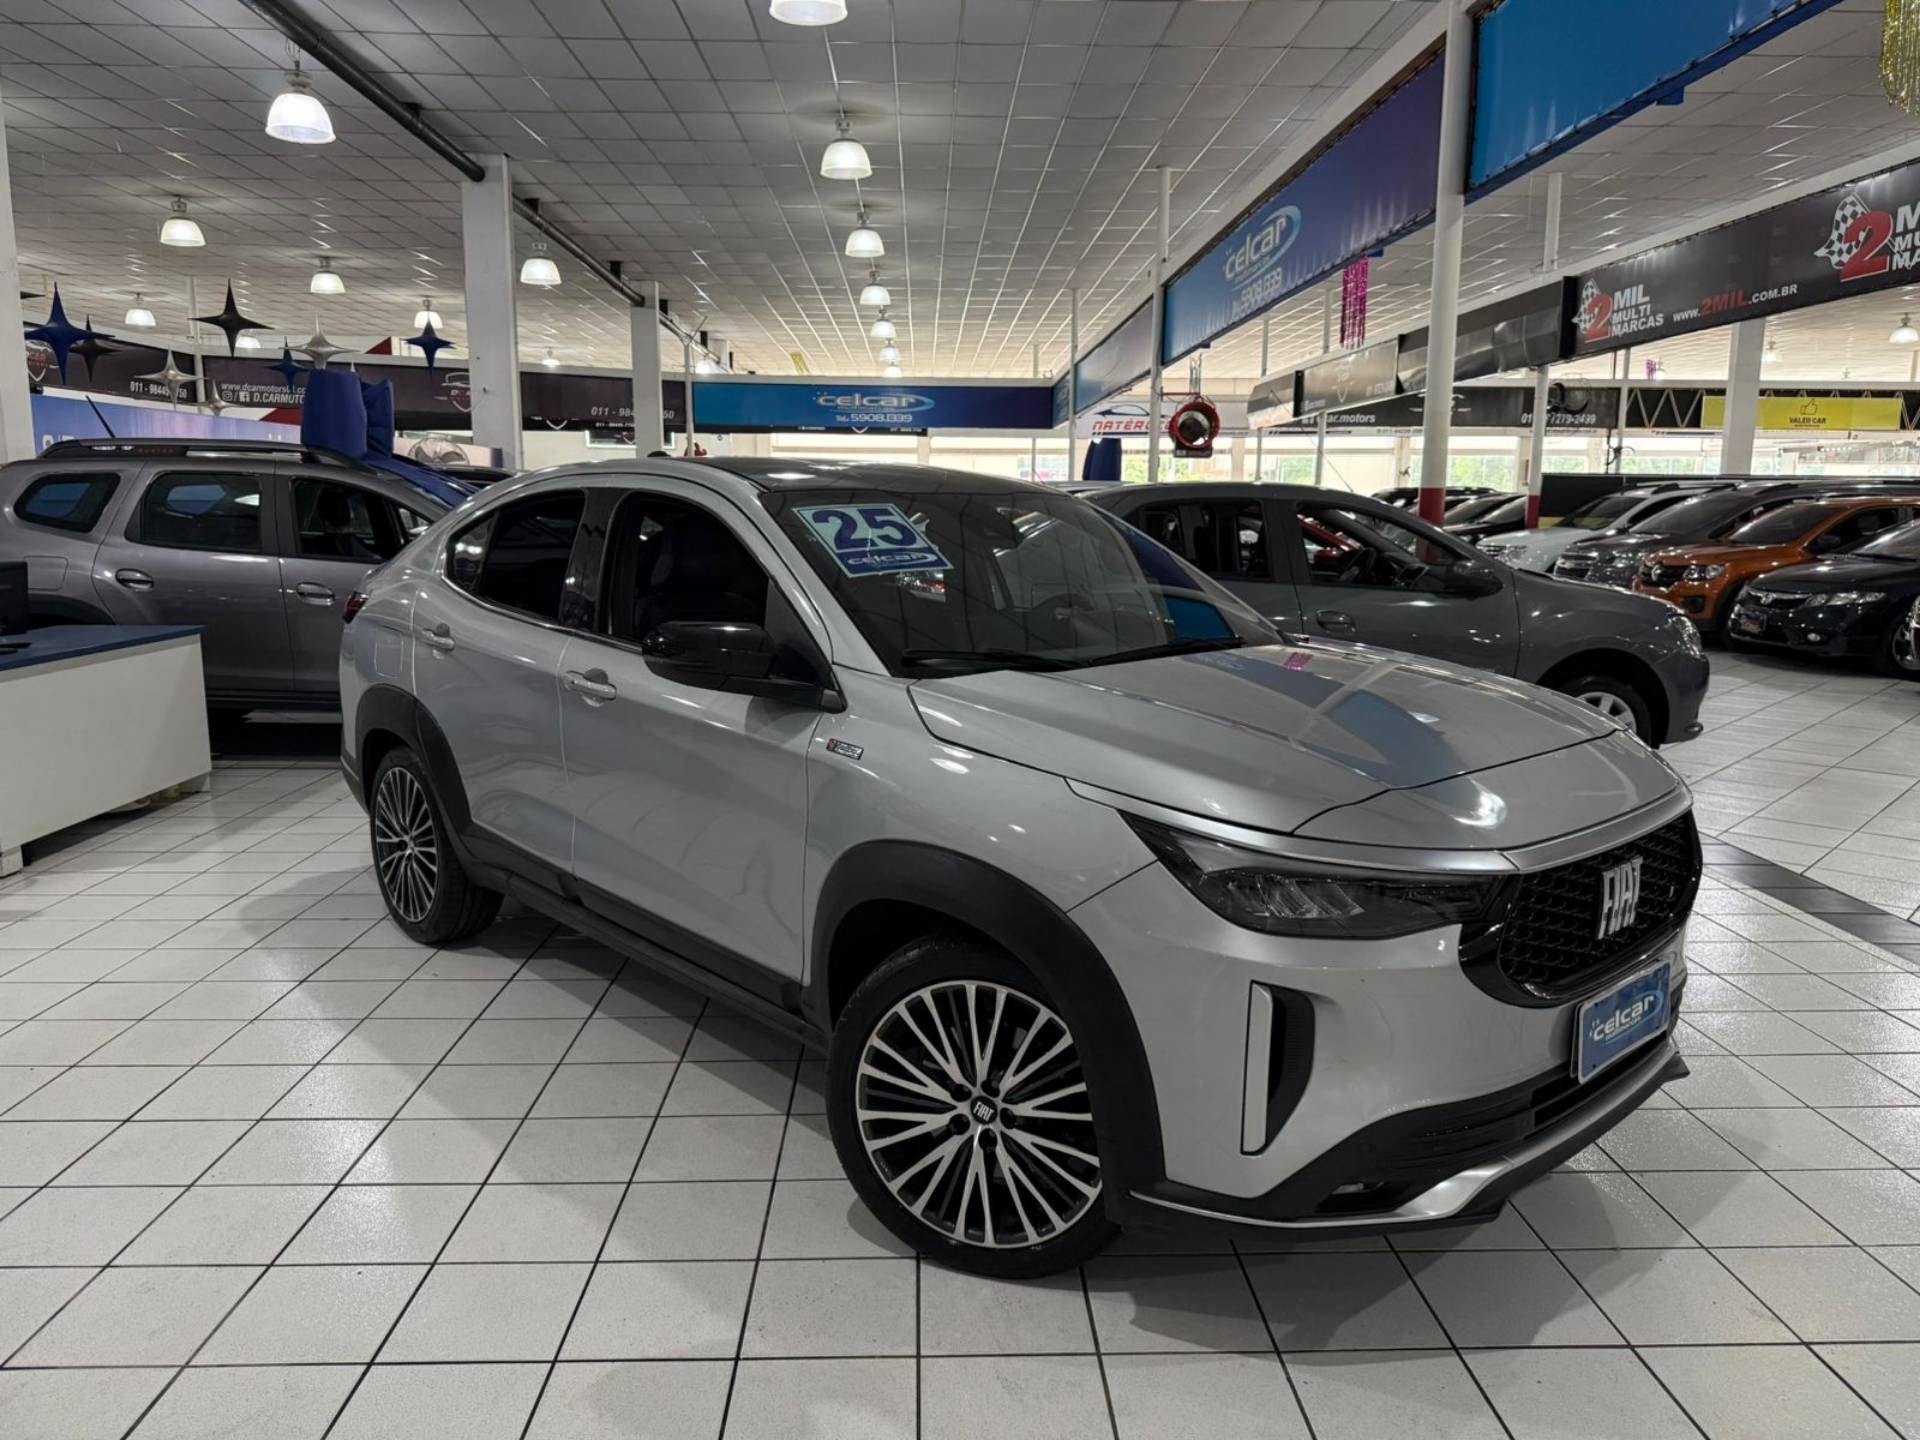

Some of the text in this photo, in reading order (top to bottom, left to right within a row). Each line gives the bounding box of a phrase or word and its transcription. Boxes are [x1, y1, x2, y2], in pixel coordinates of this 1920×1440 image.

[1225, 216, 1287, 279] celcar
[1613, 284, 1650, 311] MIL
[1611, 303, 1651, 325] MULTI
[1611, 312, 1664, 337] MARCAS
[591, 406, 609, 416] 011
[817, 393, 915, 407] celcar
[812, 508, 917, 550] 25
[1598, 856, 1643, 940] FIAT
[1593, 995, 1655, 1041] celcar
[973, 1101, 995, 1122] FIAT
